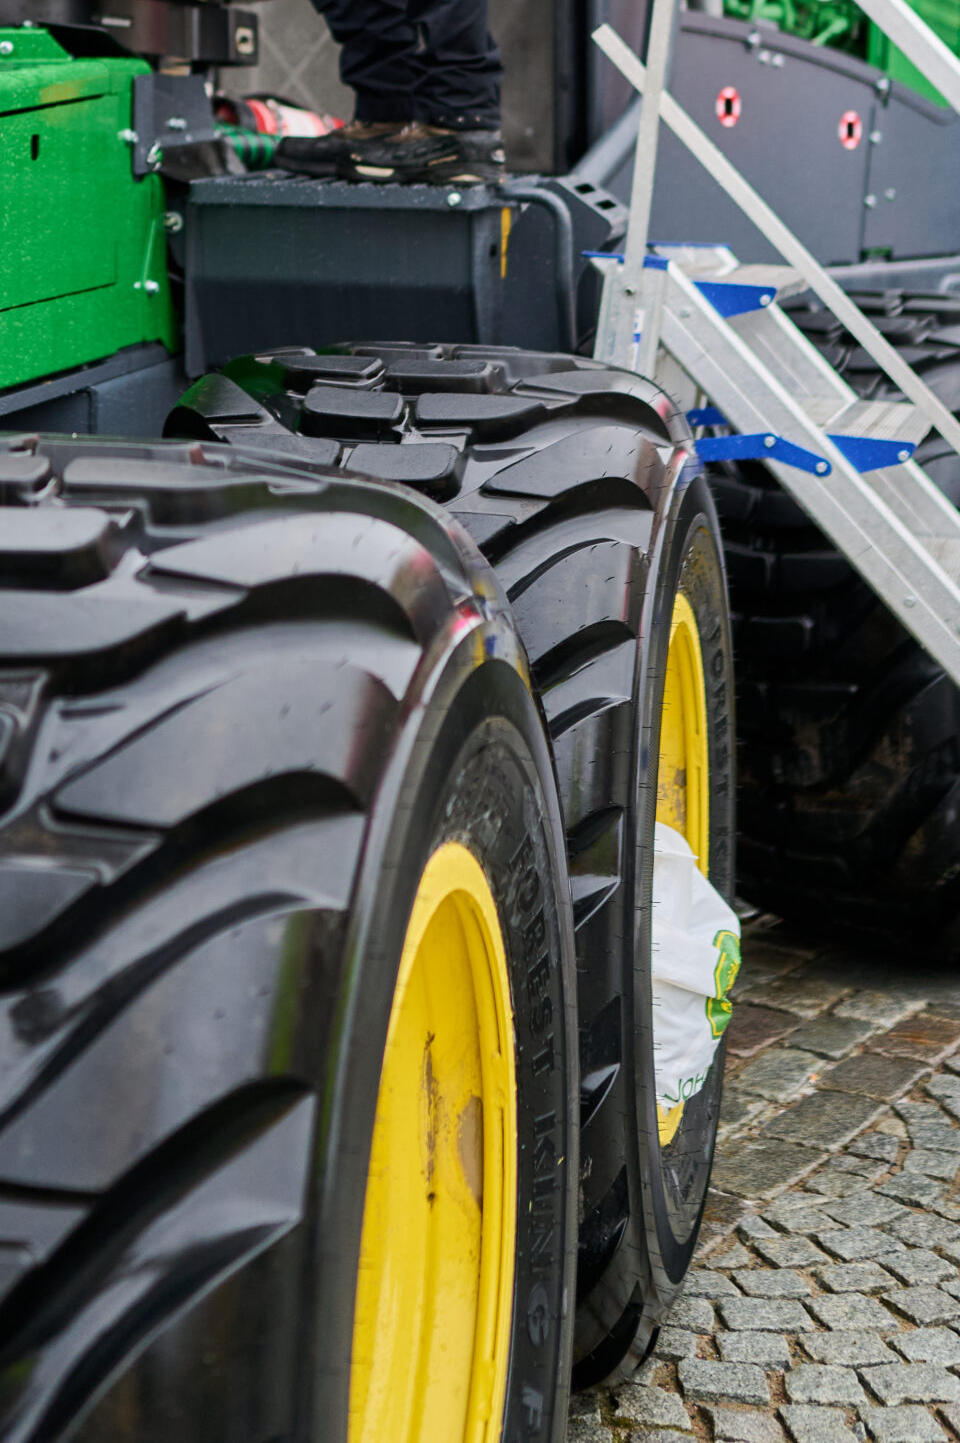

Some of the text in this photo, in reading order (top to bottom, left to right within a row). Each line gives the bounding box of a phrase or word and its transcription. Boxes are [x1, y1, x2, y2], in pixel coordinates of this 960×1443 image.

[509, 831, 556, 1078] FOREST
[663, 1066, 710, 1103] JOH
[528, 1108, 556, 1347] KING
